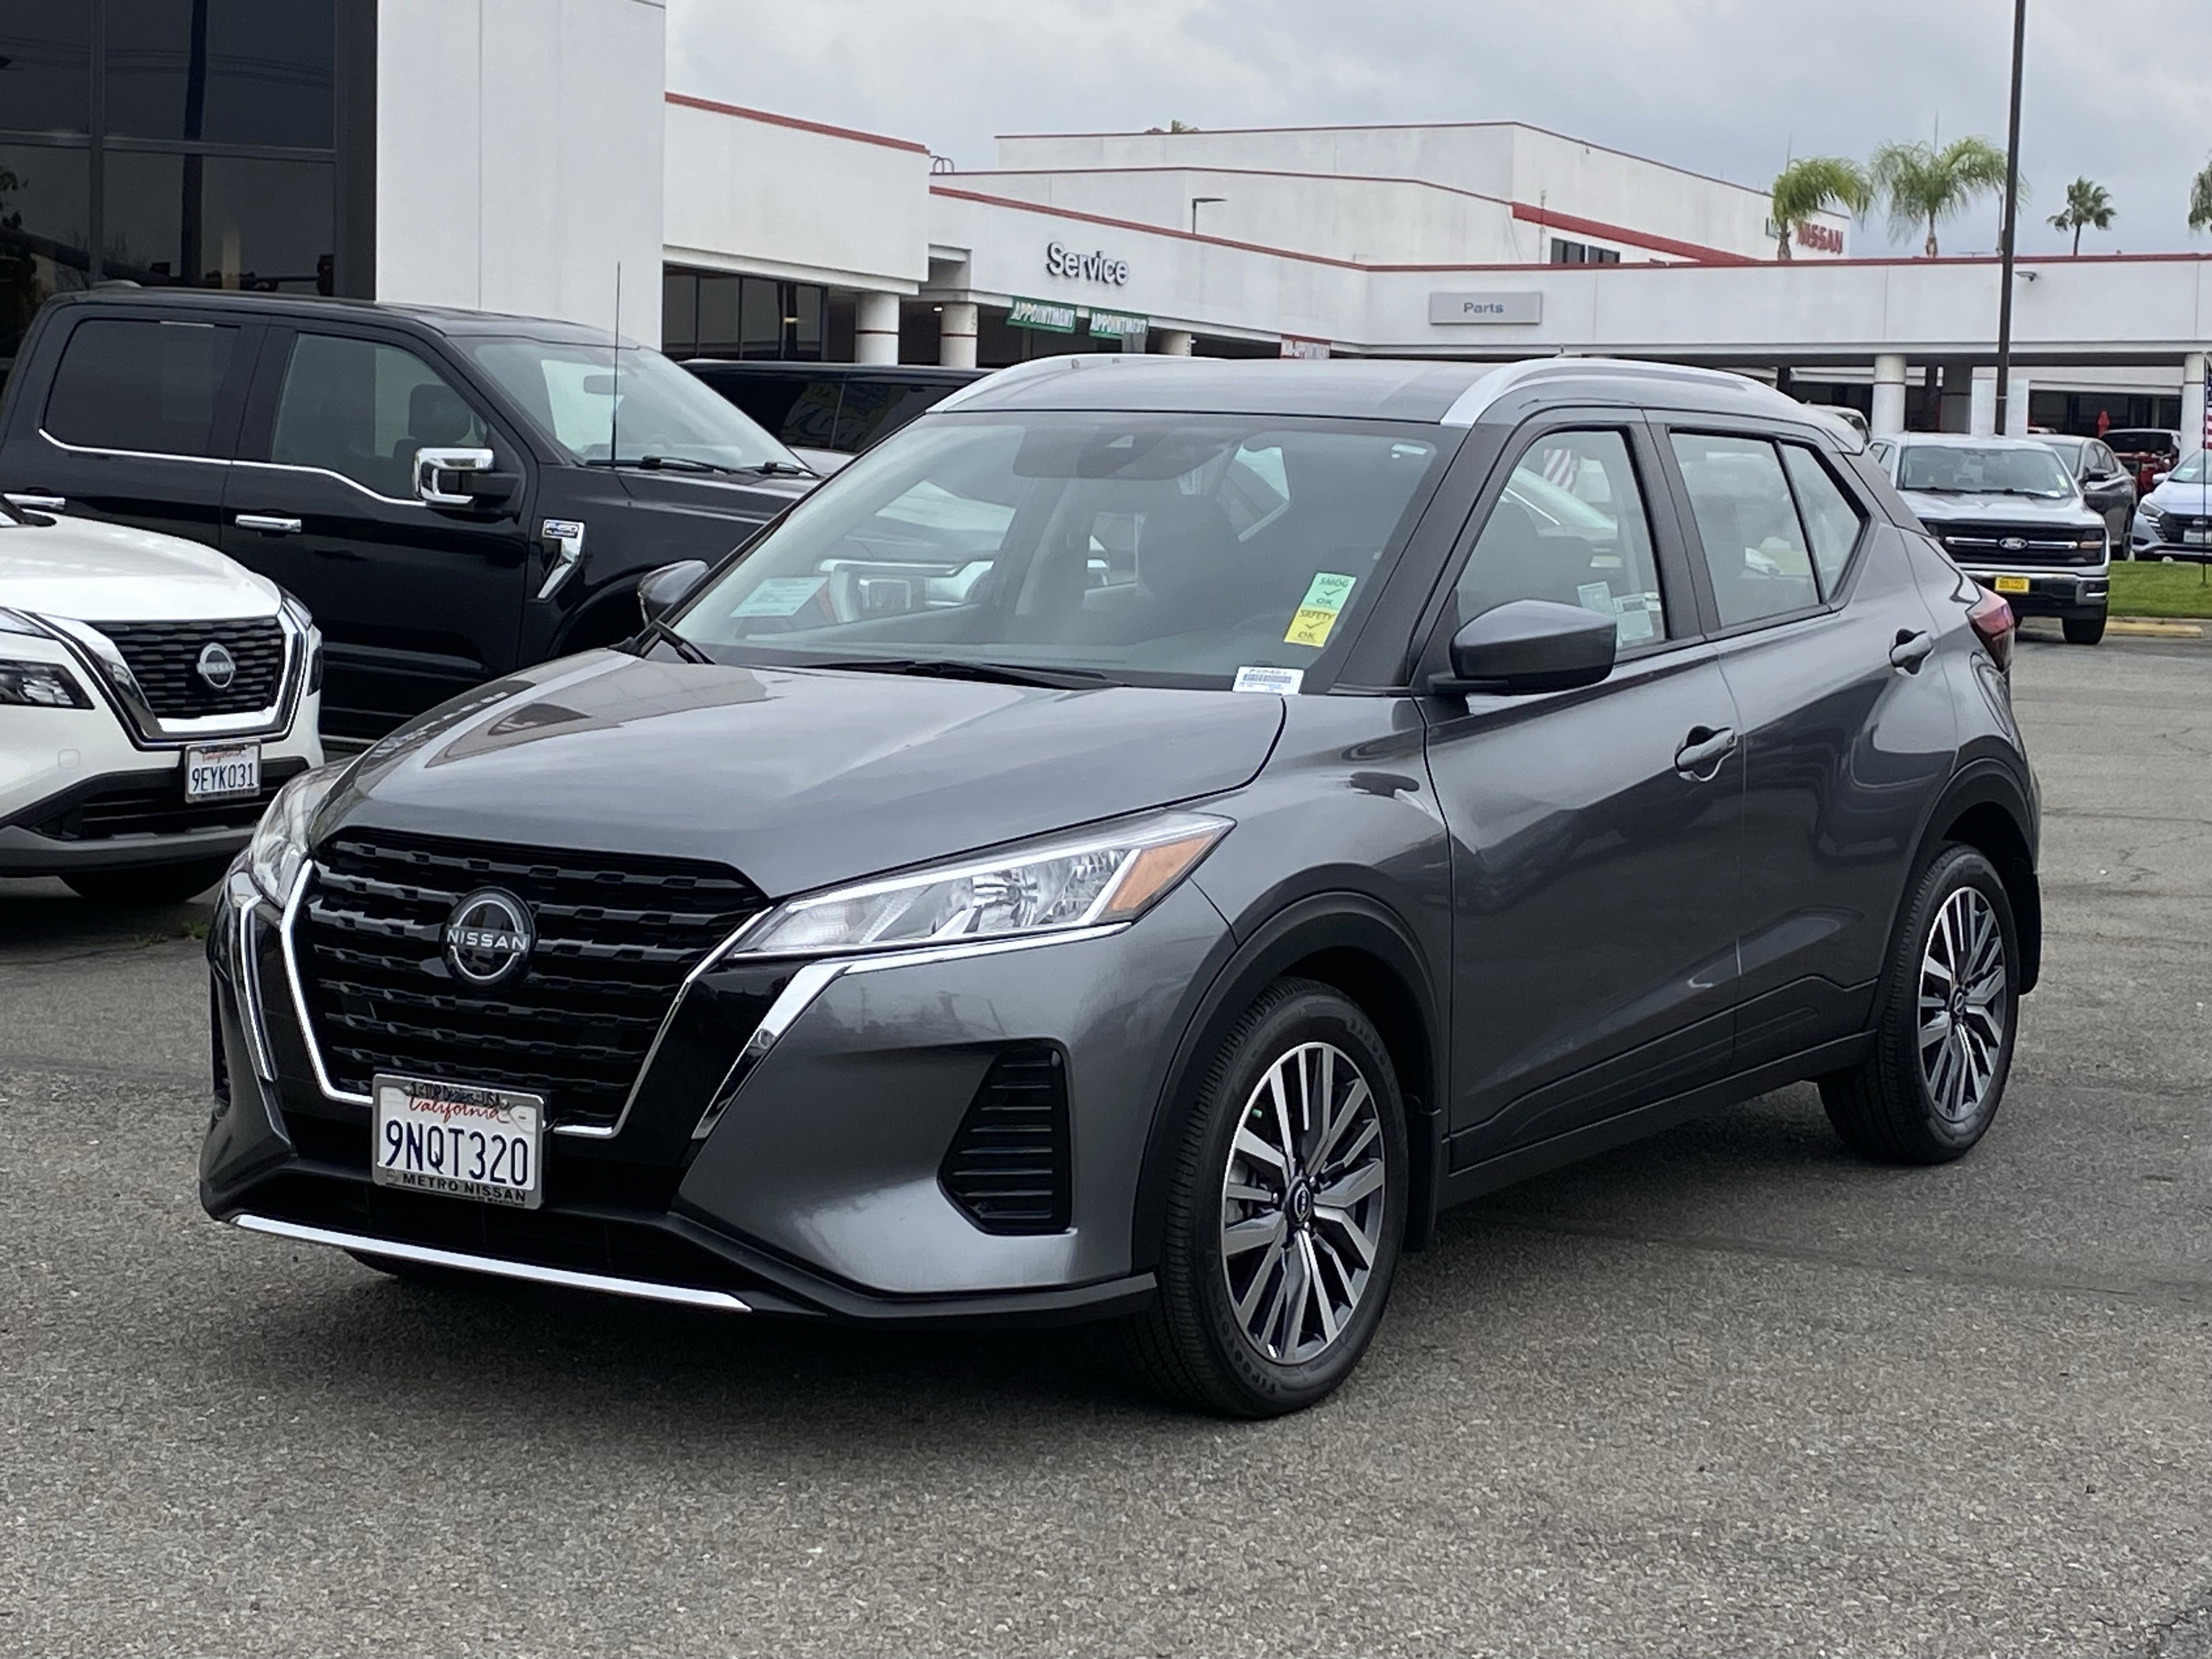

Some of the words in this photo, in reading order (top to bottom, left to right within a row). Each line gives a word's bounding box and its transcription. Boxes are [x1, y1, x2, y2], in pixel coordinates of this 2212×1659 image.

[1797, 221, 1843, 255] NISSAN
[1046, 241, 1130, 286] Service
[1011, 302, 1075, 327] APPOINTMENT
[1463, 302, 1504, 313] Parts
[1319, 577, 1349, 588] SMOG
[1316, 597, 1334, 606] OK
[1299, 610, 1335, 621] SAFETY
[1297, 631, 1317, 640] OK
[192, 763, 255, 792] 9EYK031
[447, 929, 528, 950] NISSAN
[385, 1119, 529, 1186] 9NQT320
[402, 1172, 459, 1192] METRO
[464, 1181, 526, 1202] NISSAN
